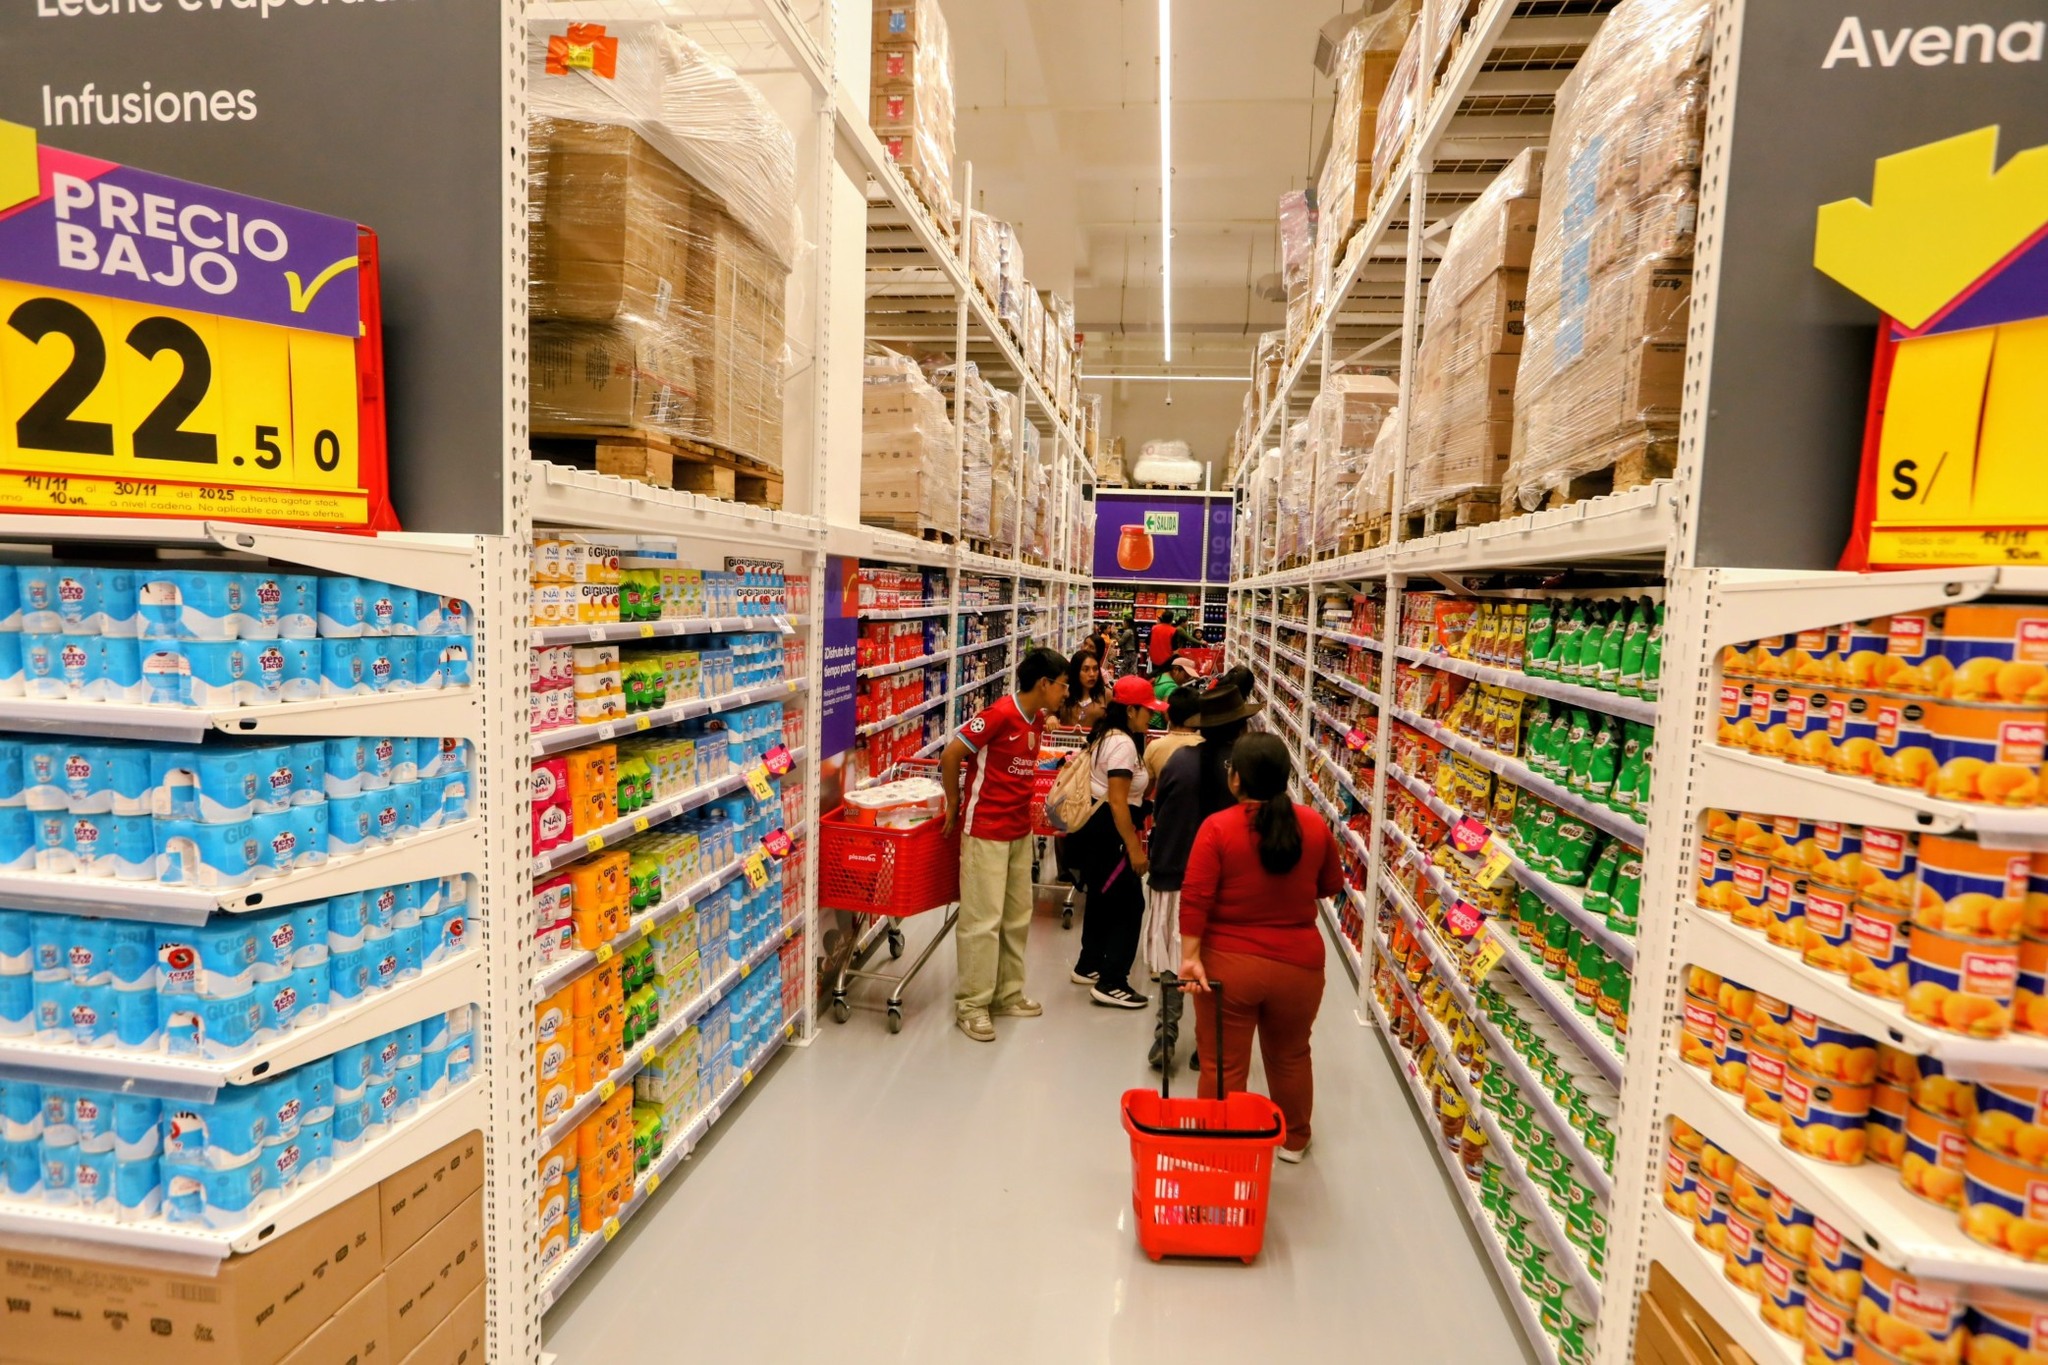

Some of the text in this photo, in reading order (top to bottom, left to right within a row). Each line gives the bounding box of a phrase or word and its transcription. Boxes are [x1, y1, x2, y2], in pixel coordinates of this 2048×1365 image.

[1821, 16, 2046, 69] Avena
[42, 81, 257, 126] Infusiones
[52, 172, 289, 262] PRECIO
[56, 221, 238, 295] BAJO
[7, 296, 218, 464] 22
[1891, 451, 1948, 505] S/
[24, 475, 68, 491] 14/11
[114, 481, 157, 497] 30/11
[176, 489, 193, 499] del
[199, 487, 235, 501] 2025
[250, 494, 278, 504] hasta
[281, 496, 311, 507] agotar
[50, 491, 67, 504] 10
[122, 500, 147, 509] nivel
[199, 503, 213, 512] No
[217, 505, 263, 516] aplicable
[287, 509, 310, 517] otras
[1156, 516, 1177, 531] SALIDA
[531, 777, 551, 790] NAN
[543, 814, 562, 828] NAN
[1456, 831, 1478, 847] BAJO
[1457, 825, 1484, 843] PRECIO
[1560, 826, 1581, 837] MILO
[752, 868, 764, 882] 22
[539, 895, 555, 909] NAN
[1451, 908, 1478, 928] PRECIO
[1451, 916, 1472, 931] BAJO
[540, 937, 555, 949] NAN
[540, 1015, 559, 1032] NAN
[543, 1052, 561, 1067] NAN
[545, 1092, 564, 1113] NAN
[542, 1162, 561, 1183] NAN
[543, 1202, 561, 1224] NAN
[542, 1243, 561, 1267] NAN
